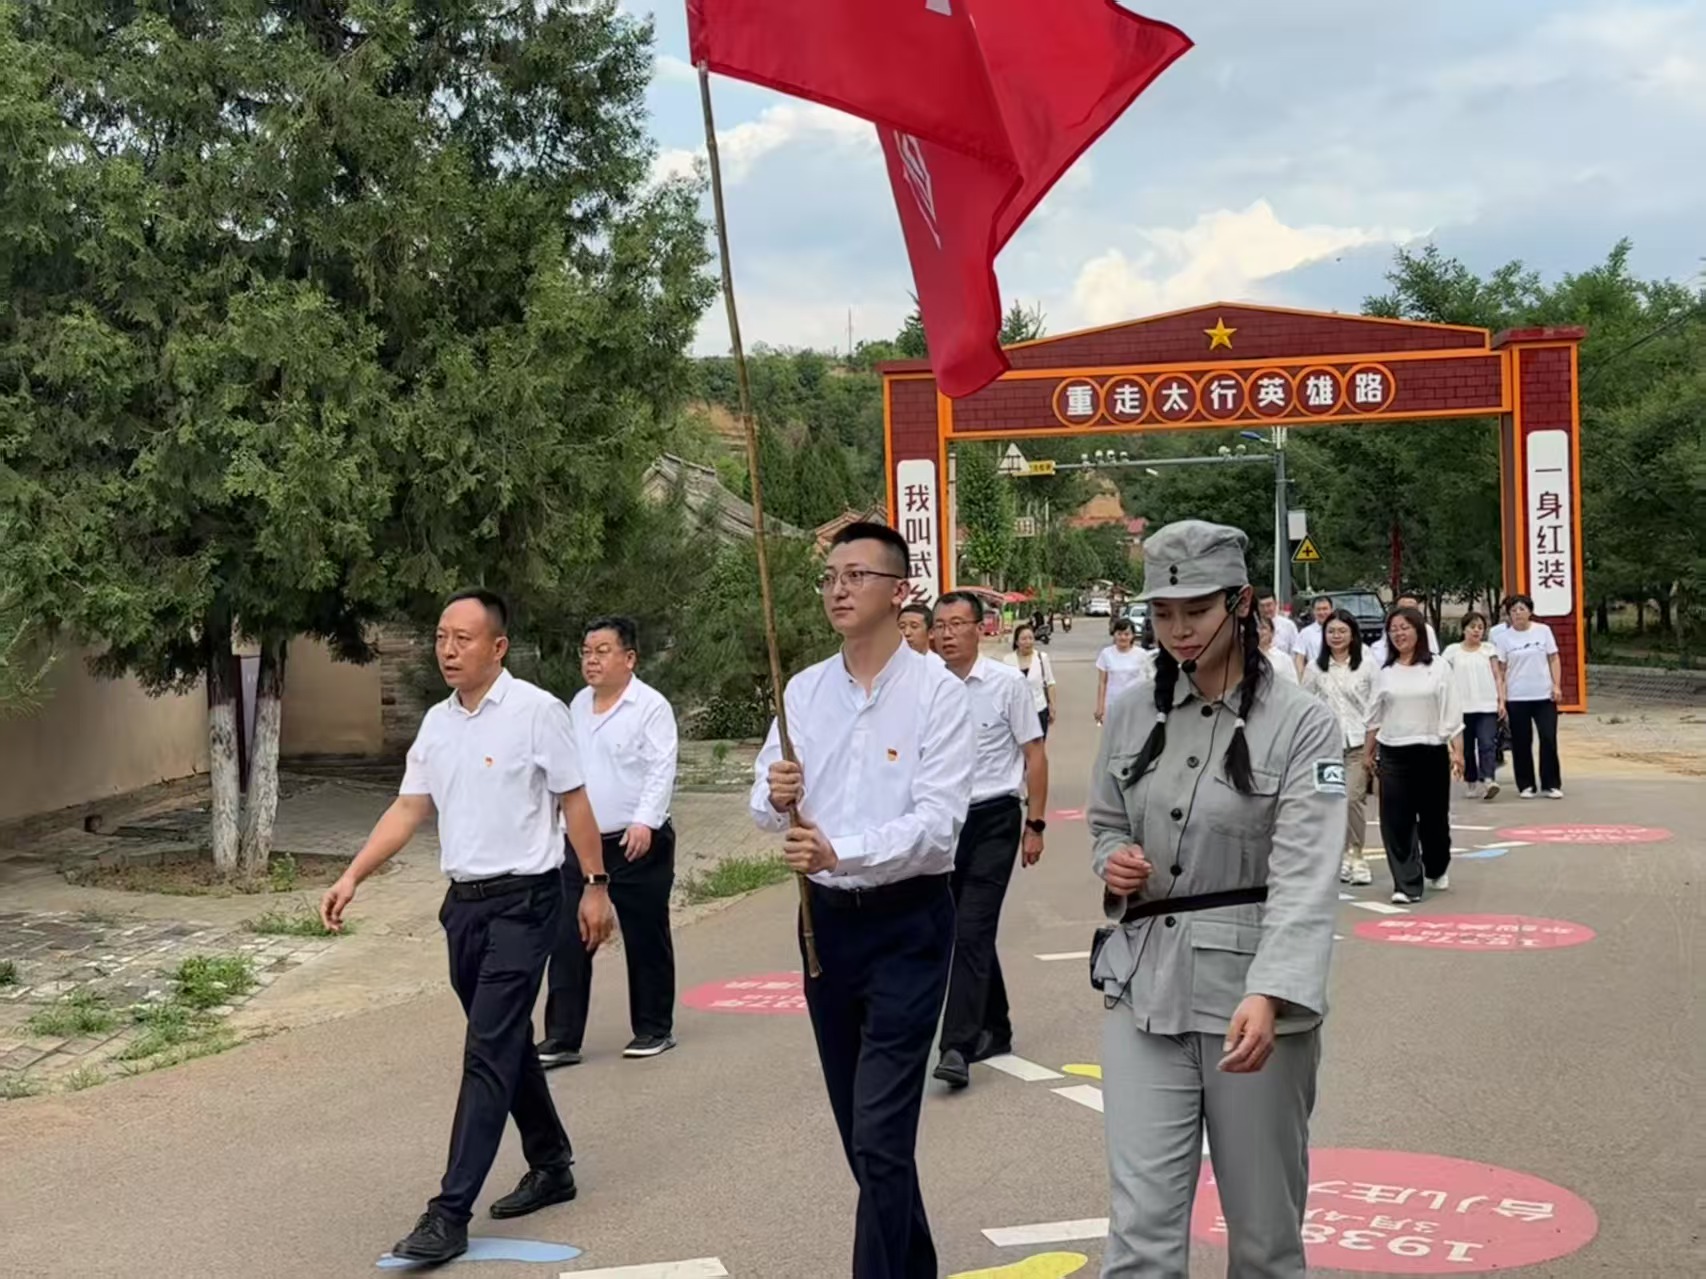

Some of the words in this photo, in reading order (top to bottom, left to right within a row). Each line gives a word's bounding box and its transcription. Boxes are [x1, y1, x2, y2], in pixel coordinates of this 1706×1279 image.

[1066, 372, 1384, 416] 重走太行英雄路
[904, 484, 932, 605] 我叫武乡
[1535, 468, 1565, 588] 一身红装
[1206, 1176, 1554, 1222] 台儿庄
